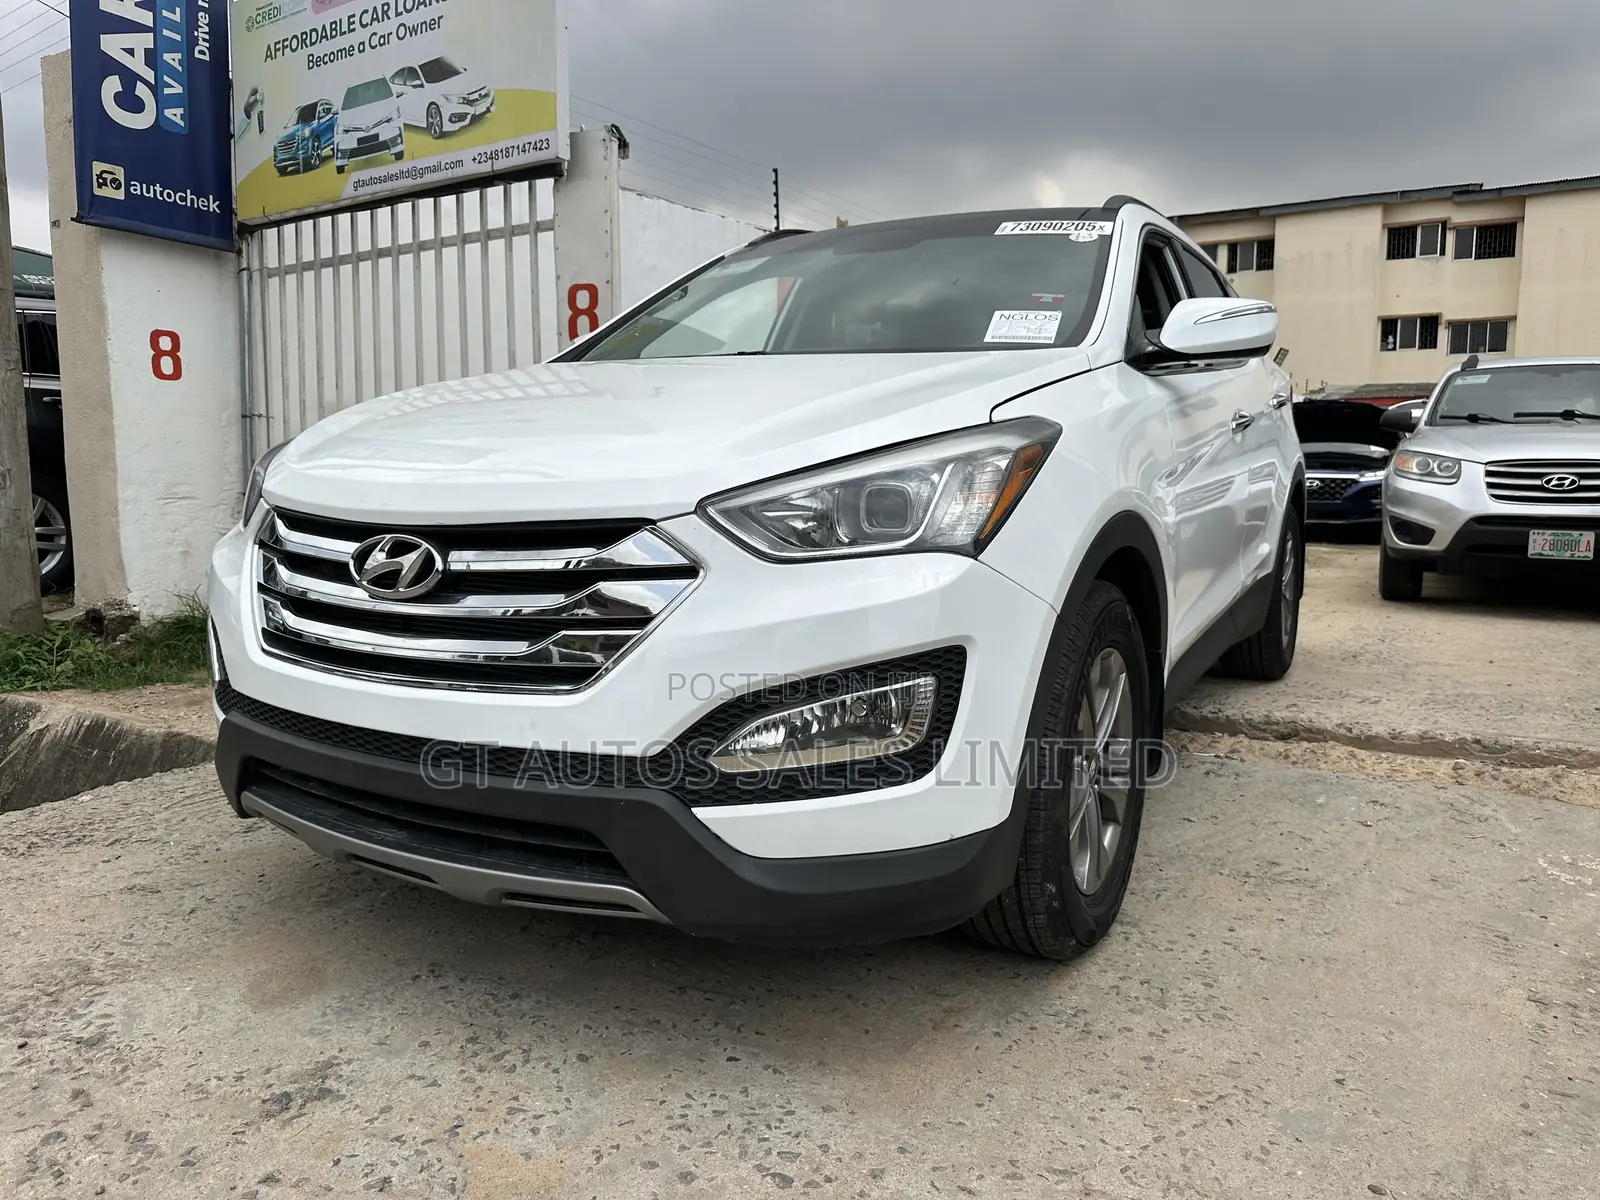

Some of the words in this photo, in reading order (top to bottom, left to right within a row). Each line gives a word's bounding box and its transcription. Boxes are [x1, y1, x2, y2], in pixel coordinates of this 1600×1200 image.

[194, 11, 210, 61] Drive
[264, 12, 356, 63] AFFORDABLE
[359, 1, 391, 29] CAR
[394, 0, 448, 18] LOA
[307, 44, 355, 70] Become
[357, 40, 366, 54] a
[368, 31, 393, 50] Car
[396, 15, 444, 41] Owner
[353, 161, 464, 191] gtautosalesltd@gmail.com
[472, 138, 550, 165] +2348187147423
[129, 180, 221, 214] autochek
[567, 283, 599, 342] 8
[999, 313, 1059, 321] NGLOS
[149, 328, 183, 382] 8
